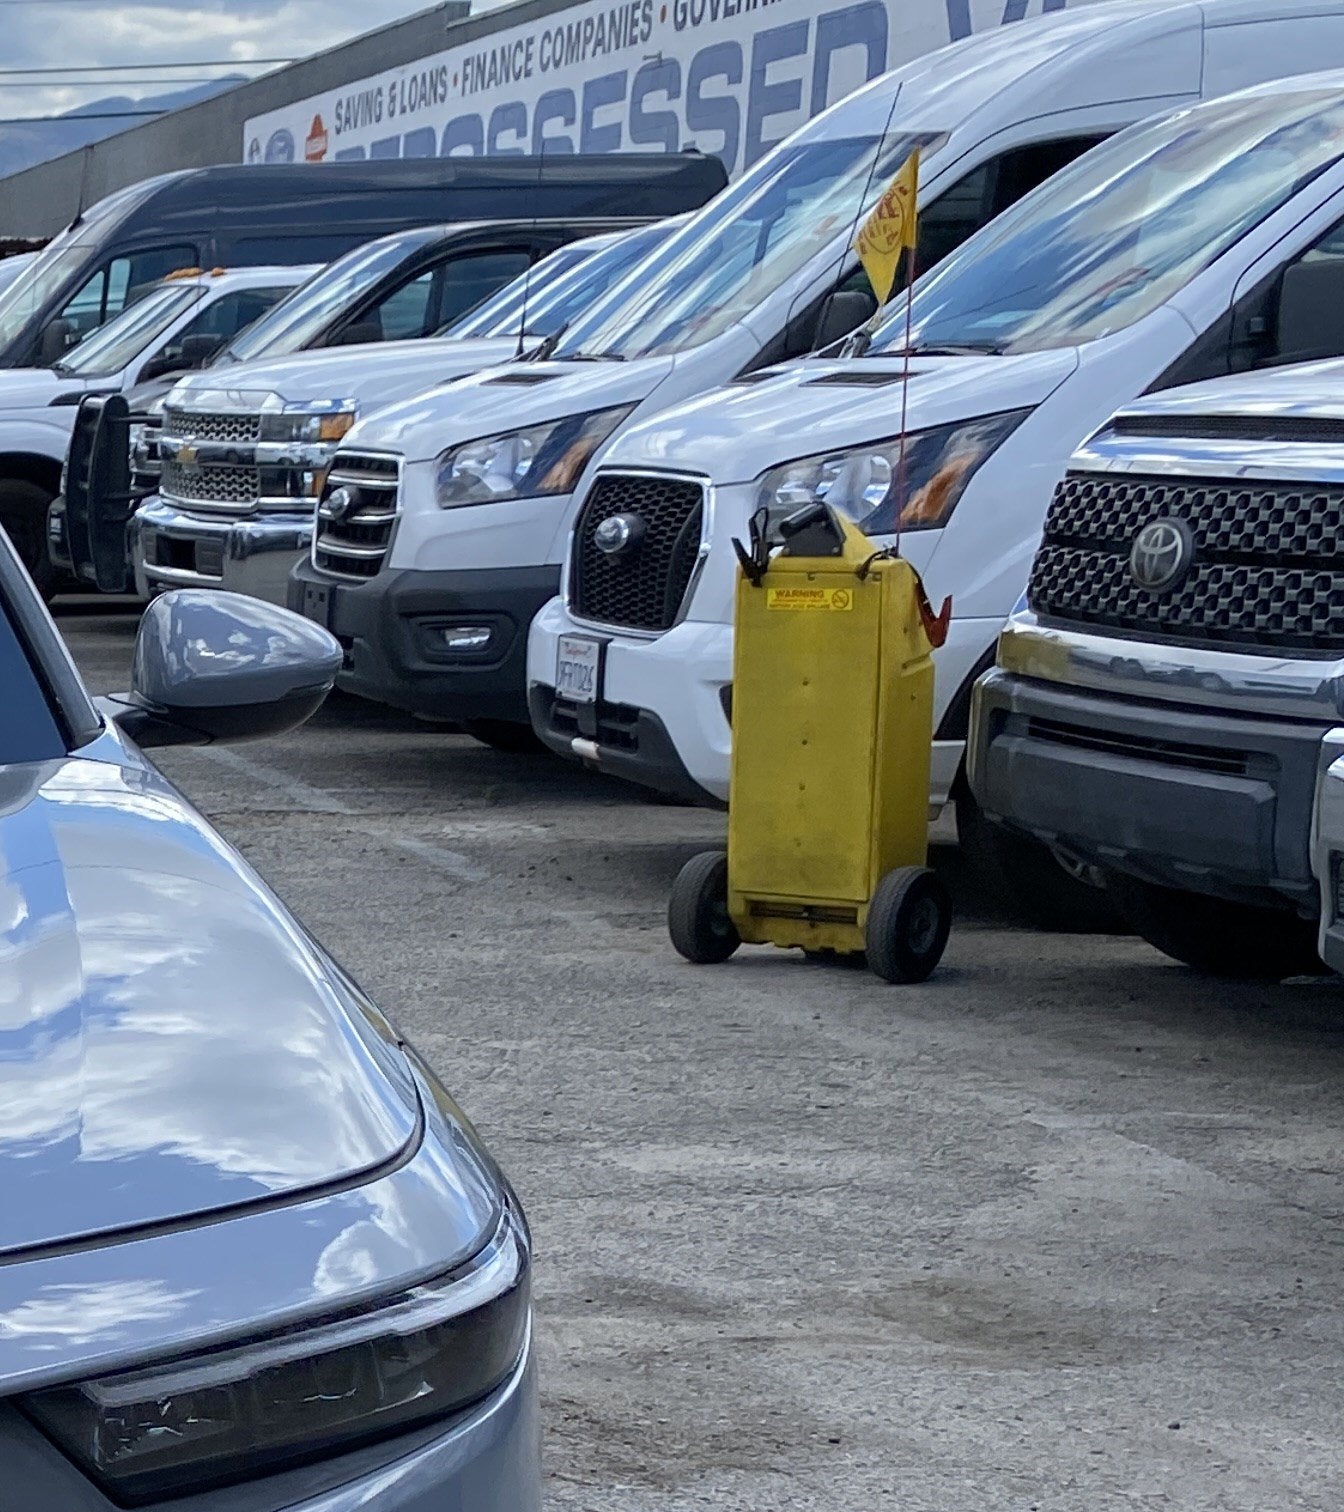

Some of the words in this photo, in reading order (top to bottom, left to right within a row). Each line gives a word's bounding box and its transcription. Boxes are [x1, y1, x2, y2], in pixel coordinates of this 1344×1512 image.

[335, 86, 383, 136] SAVING
[388, 81, 397, 118] &
[399, 65, 448, 115] LOANS
[461, 34, 535, 97] FINANCE
[539, 0, 654, 72] COMPANIES
